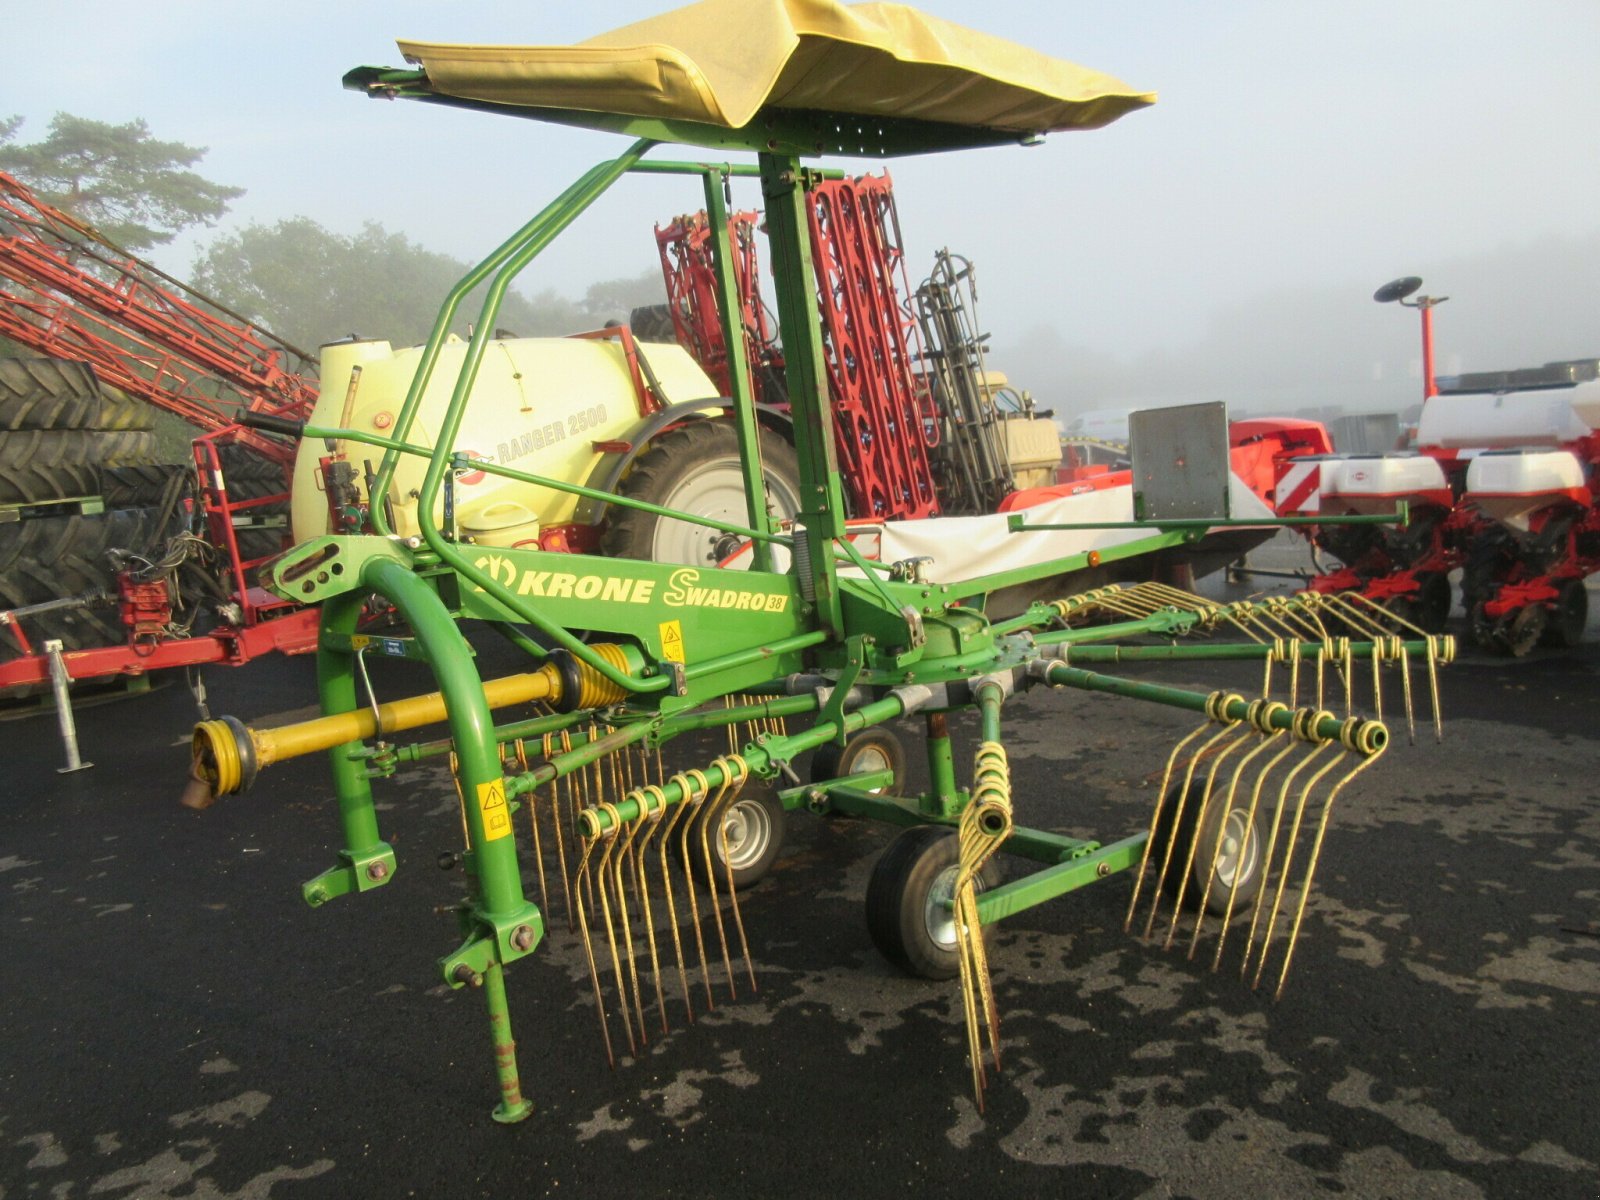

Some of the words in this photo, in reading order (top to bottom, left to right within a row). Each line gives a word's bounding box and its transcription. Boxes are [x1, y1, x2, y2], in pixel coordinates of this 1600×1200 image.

[497, 420, 566, 465] RANGER
[567, 403, 608, 436] 2500
[517, 570, 656, 604] KRONE
